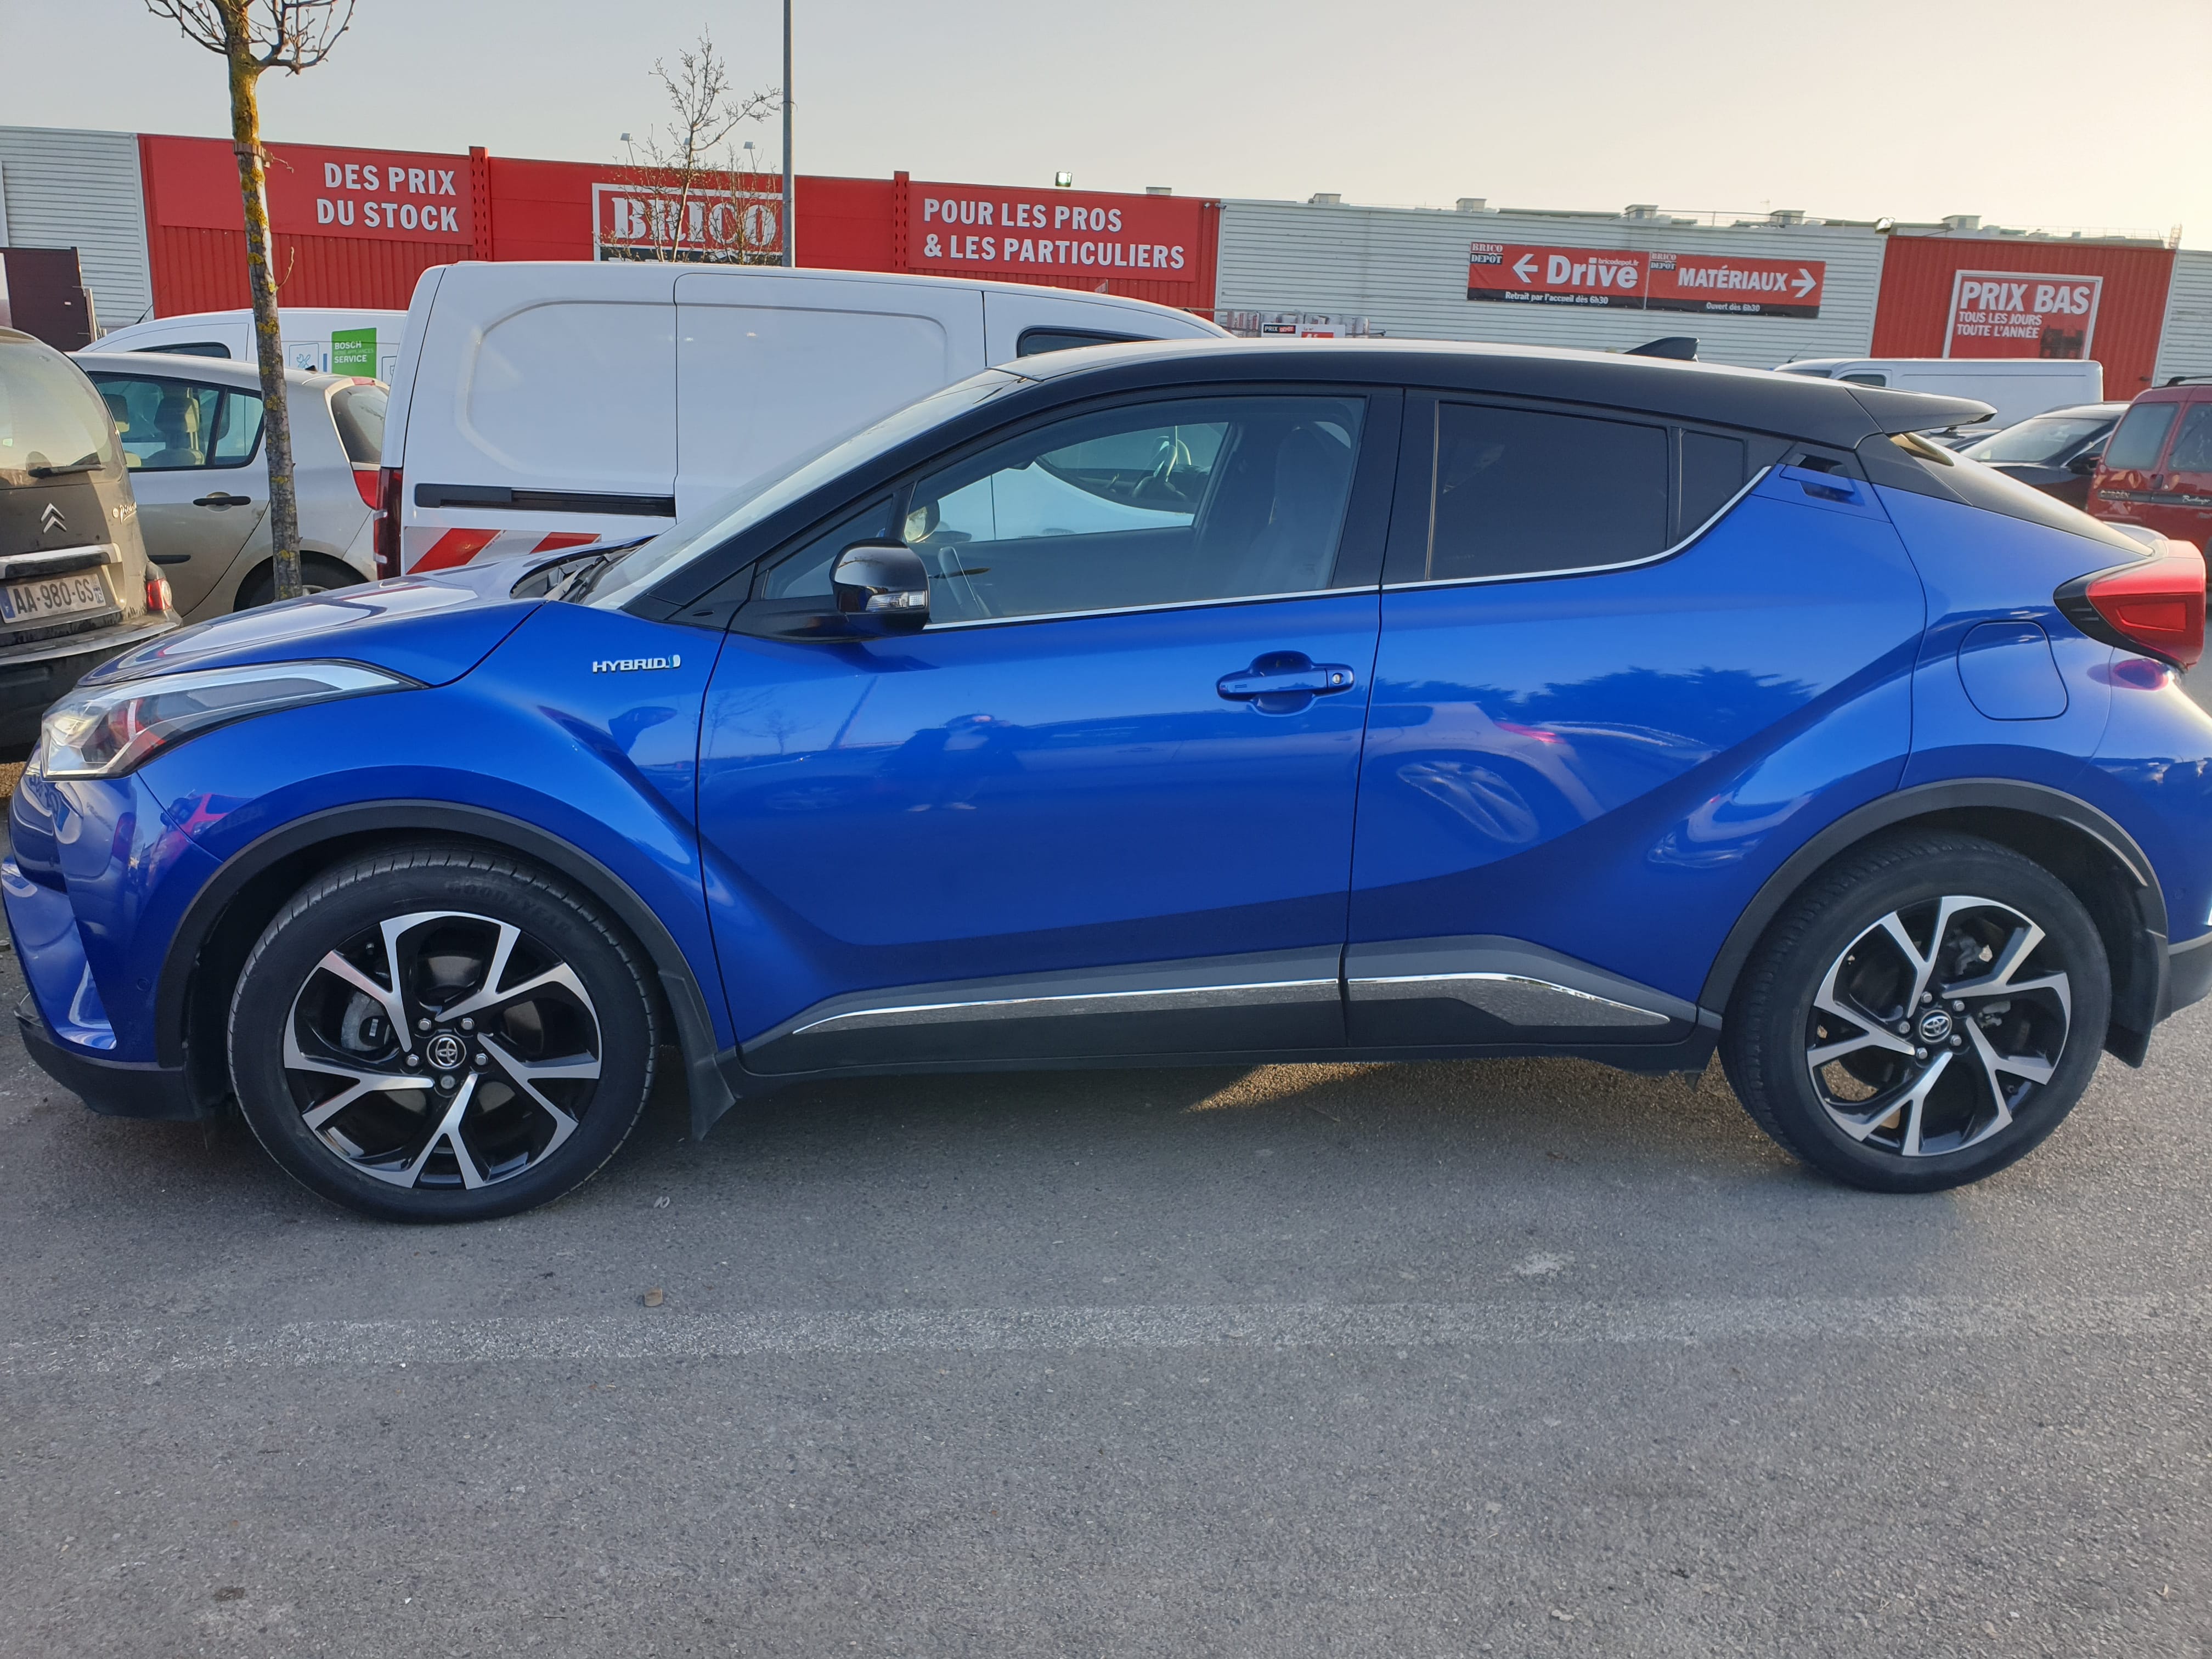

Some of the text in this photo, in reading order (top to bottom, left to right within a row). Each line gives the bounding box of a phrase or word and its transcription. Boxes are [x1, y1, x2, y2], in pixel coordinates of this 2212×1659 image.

[324, 162, 456, 195] DES PRIX
[317, 199, 459, 232] DU STOCK
[612, 197, 776, 246] BRICO
[924, 198, 1122, 233] POUR LES PROS
[924, 233, 1184, 269] & LES PARTICULIERS
[1472, 243, 1503, 252] BRICO
[1547, 255, 1638, 289] Drive
[1678, 264, 1788, 292] MATÉRIAUX
[1505, 291, 1529, 301] Retrait
[1576, 295, 1588, 303] dès
[1706, 302, 1760, 313] Ouvert dès 6h30
[1960, 281, 2090, 315] PRIX BAS
[1957, 324, 1990, 336] TOUTE
[1959, 311, 2042, 326] TOUS LES JOURS
[334, 354, 367, 363] SERVICE
[335, 341, 362, 349] BOSCH
[13, 579, 94, 614] AA-980-GS
[592, 658, 667, 672] HYBRID
